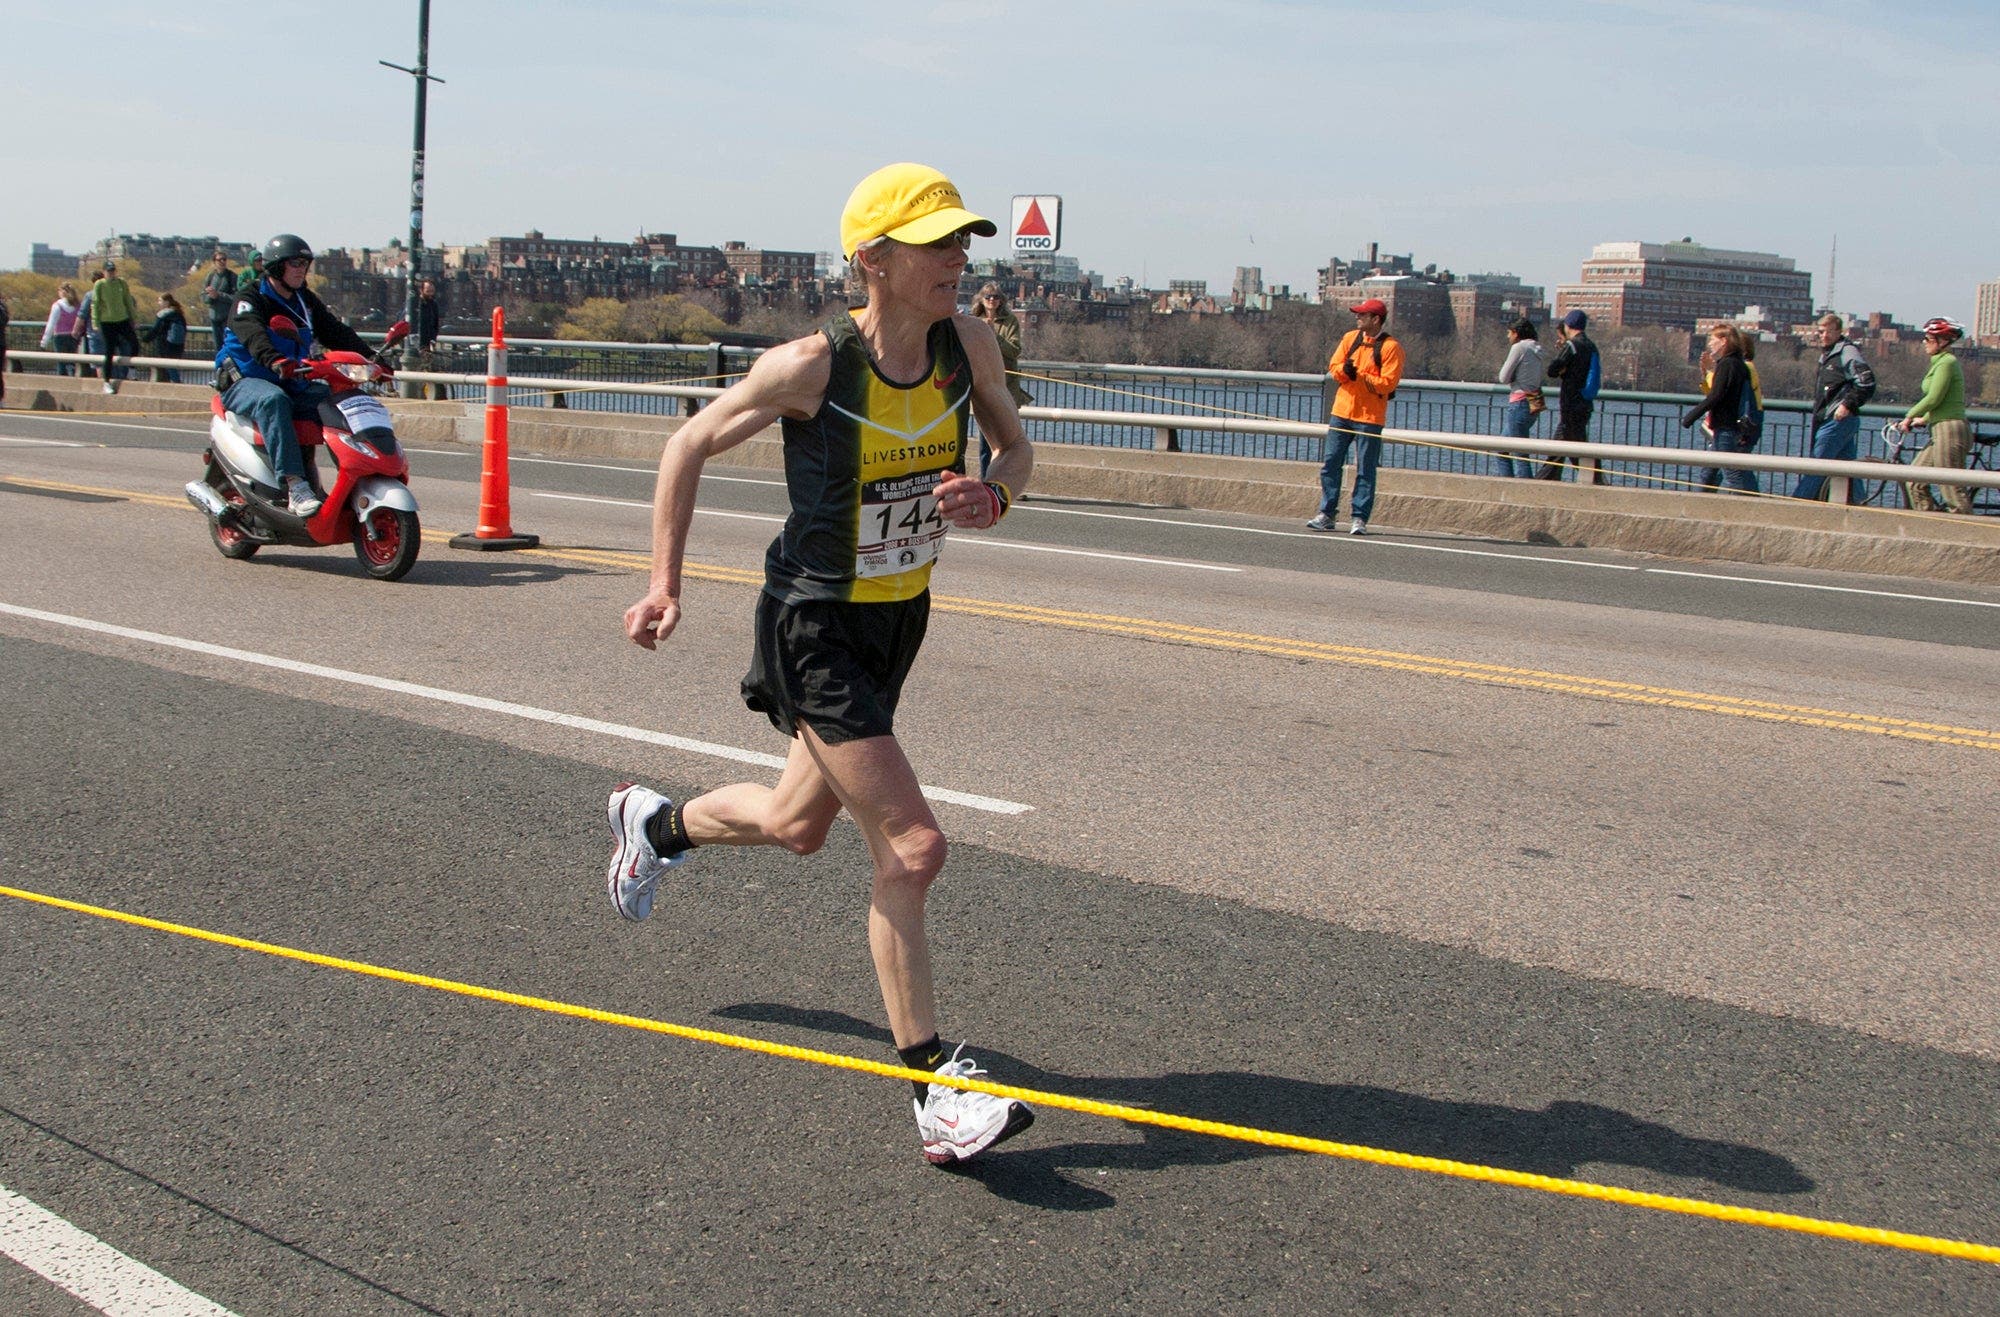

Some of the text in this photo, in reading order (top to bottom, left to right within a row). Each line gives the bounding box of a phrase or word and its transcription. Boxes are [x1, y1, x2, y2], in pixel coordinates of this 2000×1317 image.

[1016, 237, 1051, 248] CITGO
[863, 441, 956, 465] LIVESTRONG
[875, 482, 888, 492] U.S.
[889, 478, 914, 491] OLYMPIC
[914, 475, 930, 486] TEAM
[882, 489, 911, 500] WOMEN'S
[876, 497, 945, 540] 144
